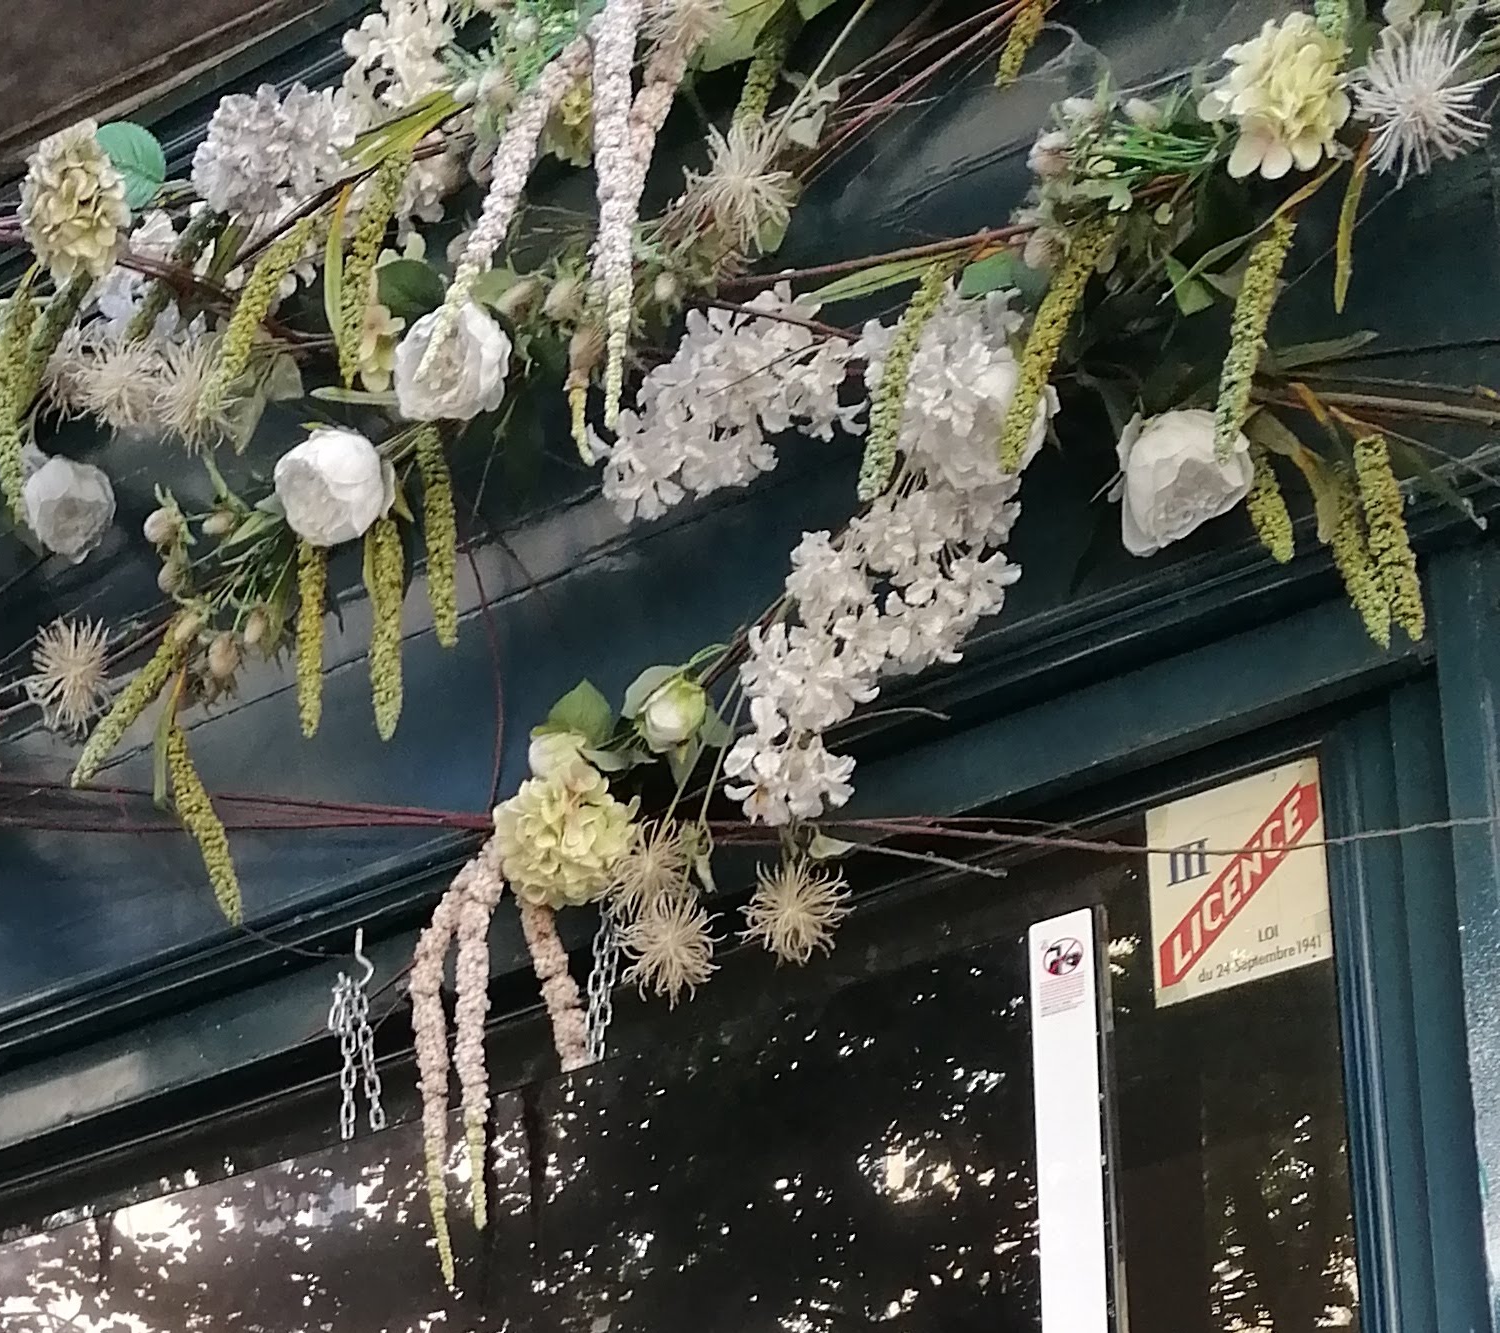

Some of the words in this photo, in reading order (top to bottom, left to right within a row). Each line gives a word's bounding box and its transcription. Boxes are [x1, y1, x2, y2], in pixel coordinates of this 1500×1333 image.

[1171, 790, 1304, 976] LICENCE
[1198, 969, 1213, 983] du
[1296, 934, 1323, 954] 1941
[1257, 925, 1279, 943] LOI
